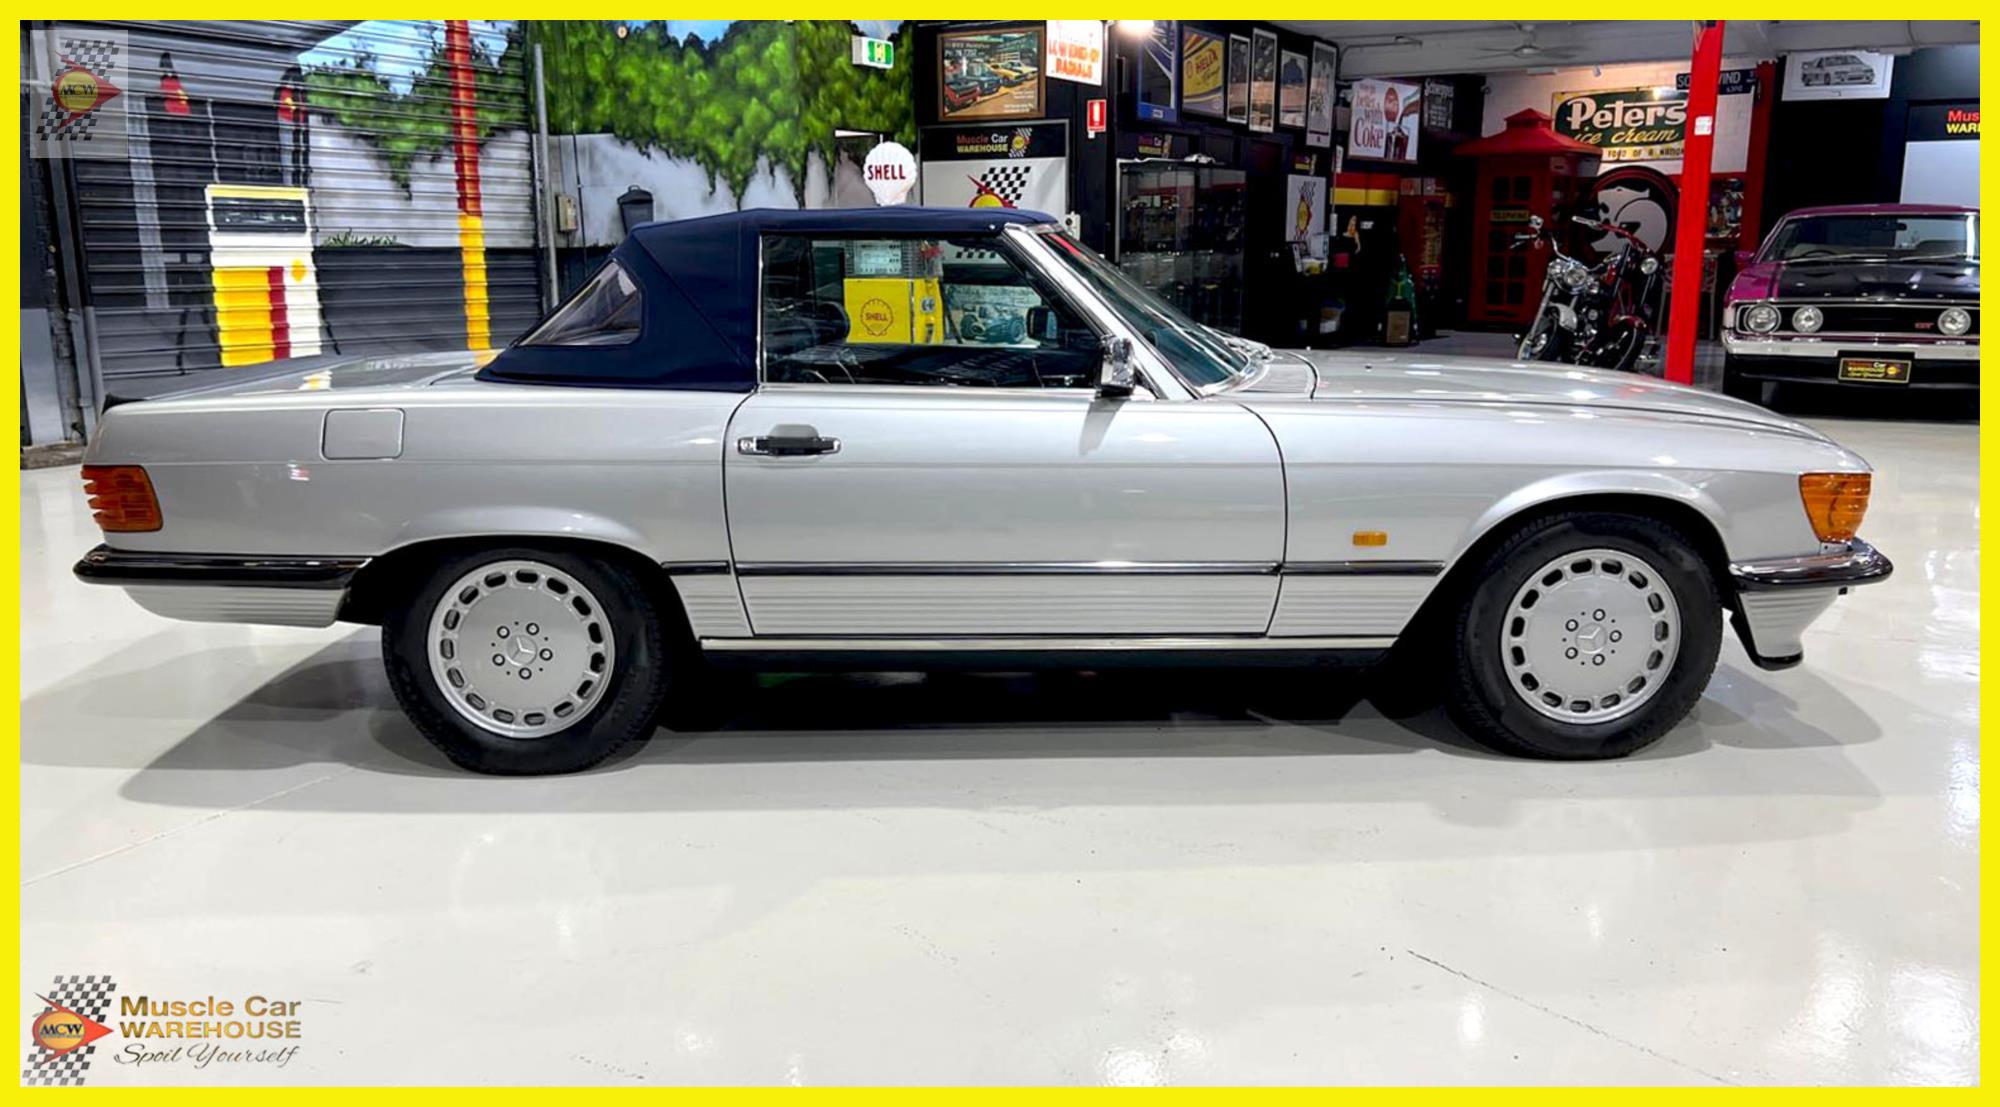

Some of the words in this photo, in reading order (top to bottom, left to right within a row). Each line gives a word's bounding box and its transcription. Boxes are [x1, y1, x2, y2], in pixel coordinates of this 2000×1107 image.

[1567, 96, 1688, 131] Peters
[991, 133, 1008, 143] Car
[1354, 117, 1384, 148] Coke
[1573, 126, 1602, 145] ice
[1611, 127, 1679, 145] cream
[956, 144, 1008, 153] WAREHOUSE
[1633, 149, 1642, 158] OF
[867, 164, 906, 180] SHELL
[865, 312, 888, 321] SHELL
